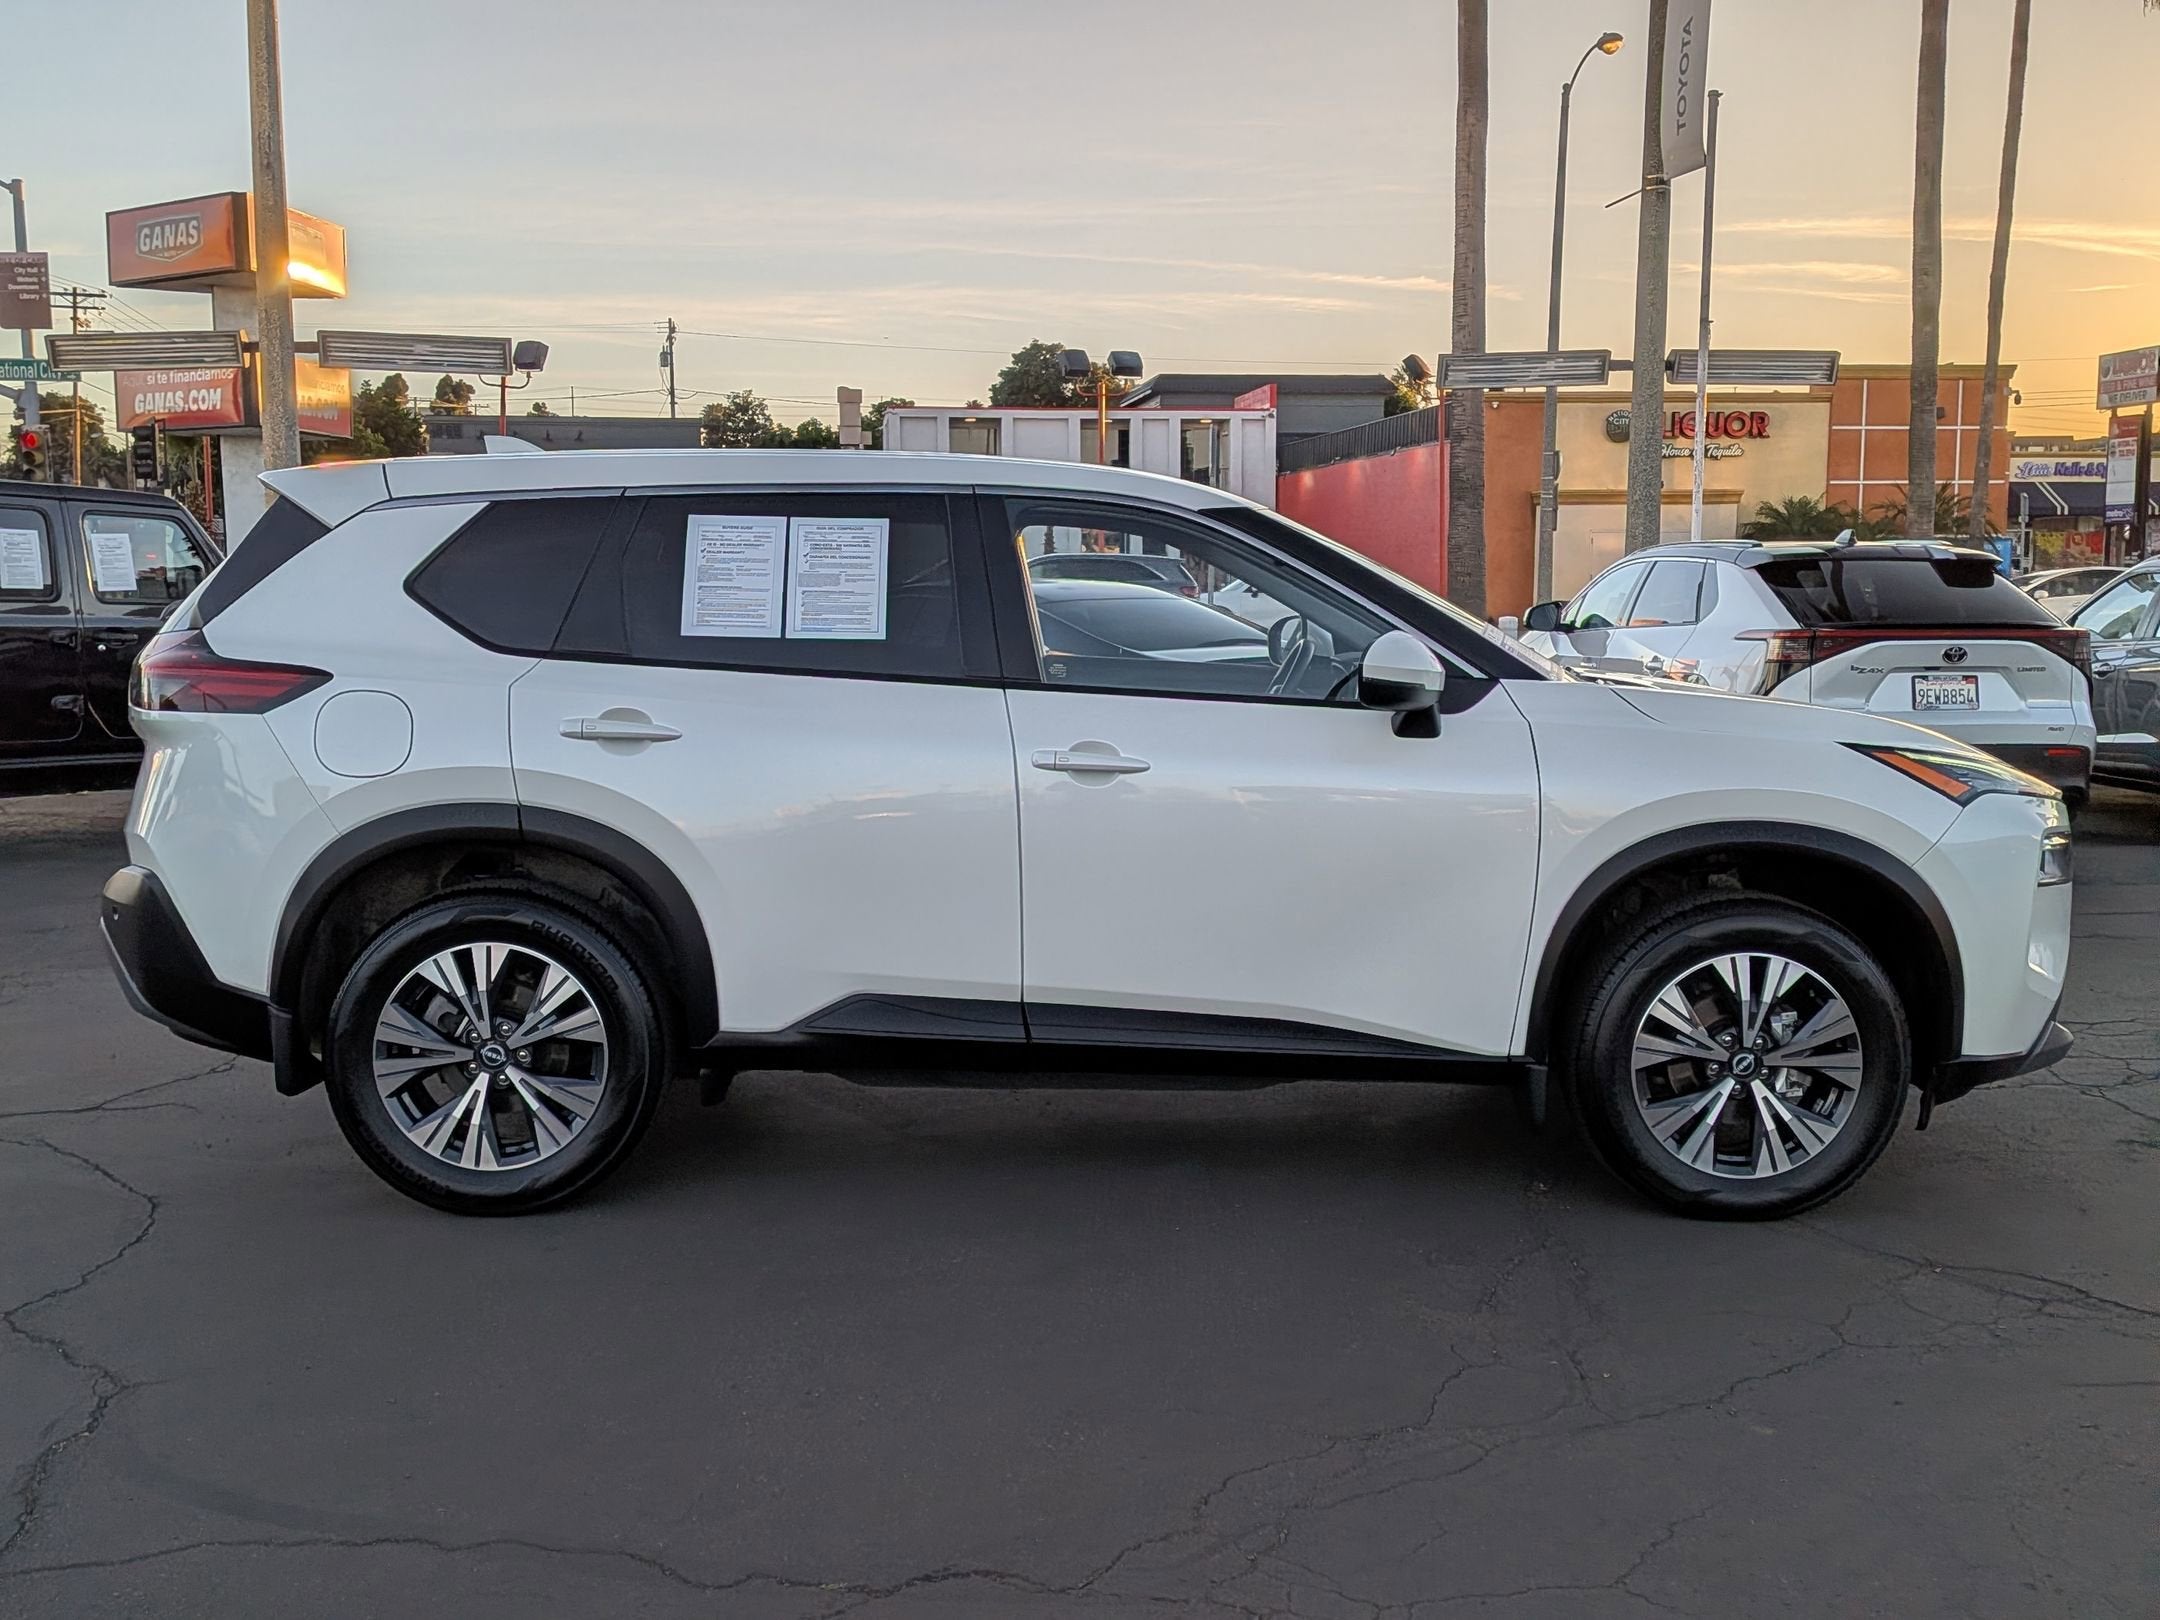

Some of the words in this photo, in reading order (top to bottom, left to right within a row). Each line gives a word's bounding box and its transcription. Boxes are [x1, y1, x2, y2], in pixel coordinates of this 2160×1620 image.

[1676, 15, 1694, 137] TOYOTA
[139, 220, 198, 252] GANAS
[19, 293, 40, 301] Library
[0, 361, 38, 378] ational
[157, 371, 168, 385] te
[134, 387, 222, 415] GANAS.COM
[1662, 411, 1771, 439] LIQUOR
[1662, 444, 1691, 457] House
[1706, 444, 1743, 460] Tequila
[2054, 462, 2084, 476] Nails
[1918, 688, 1975, 704] 9EWB854
